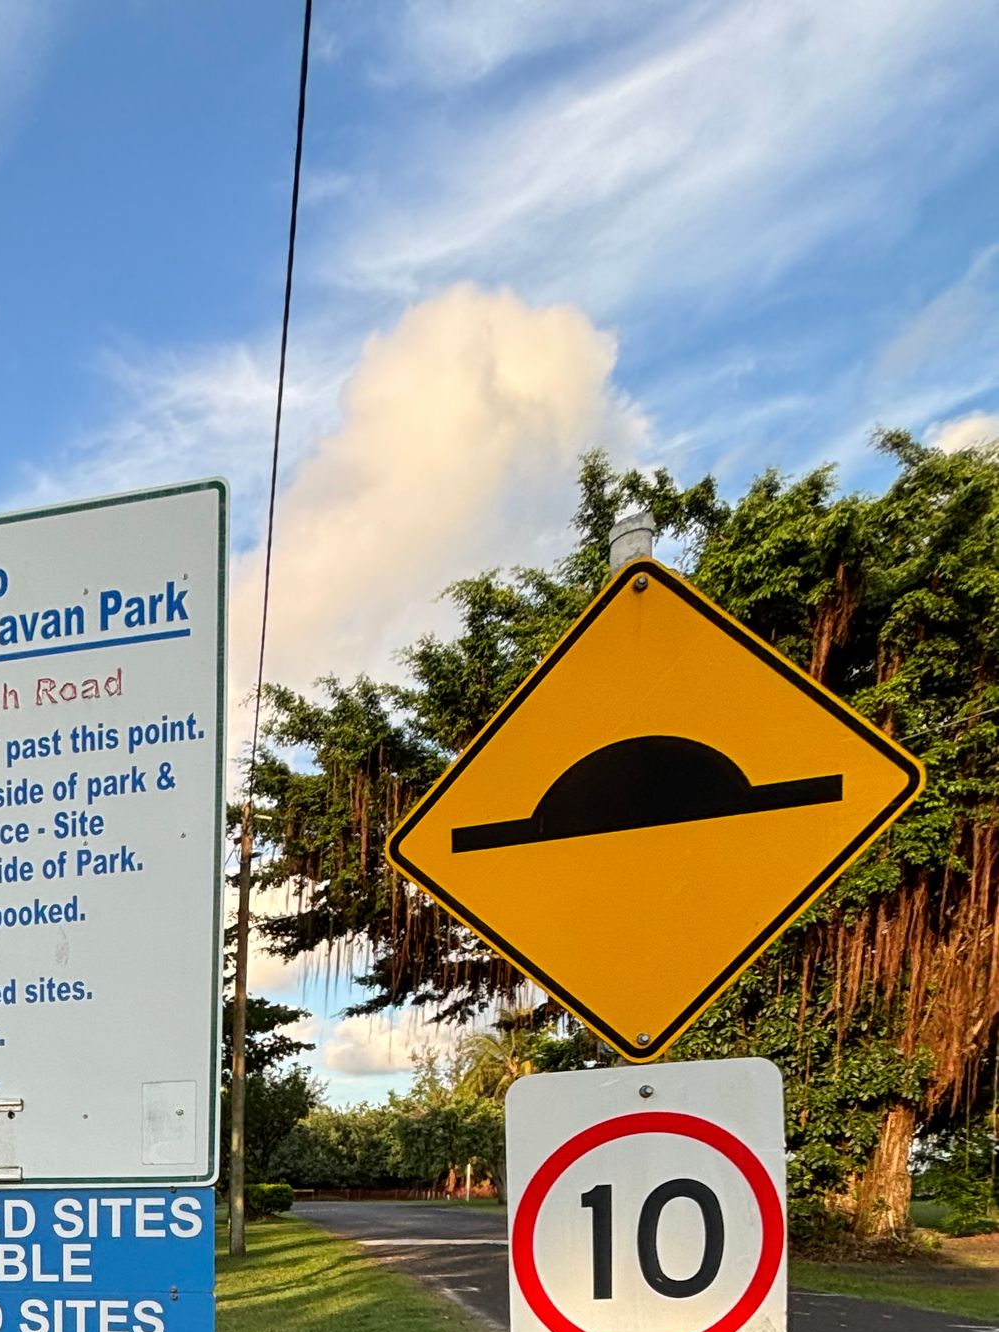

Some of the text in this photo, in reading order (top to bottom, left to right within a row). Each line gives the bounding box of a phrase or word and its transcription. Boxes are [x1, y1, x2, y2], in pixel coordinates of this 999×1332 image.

[99, 579, 189, 632] Park
[36, 667, 122, 705] Road
[5, 731, 62, 762] past
[70, 725, 119, 753] this
[127, 714, 205, 748] point.
[52, 771, 78, 801] of
[87, 766, 147, 801] park
[155, 761, 175, 791] &
[53, 809, 104, 839] Site
[42, 850, 67, 879] of
[76, 846, 143, 874] Park.
[25, 978, 93, 1002] sites.
[53, 1195, 202, 1238] SITES
[580, 1177, 725, 1300] 10
